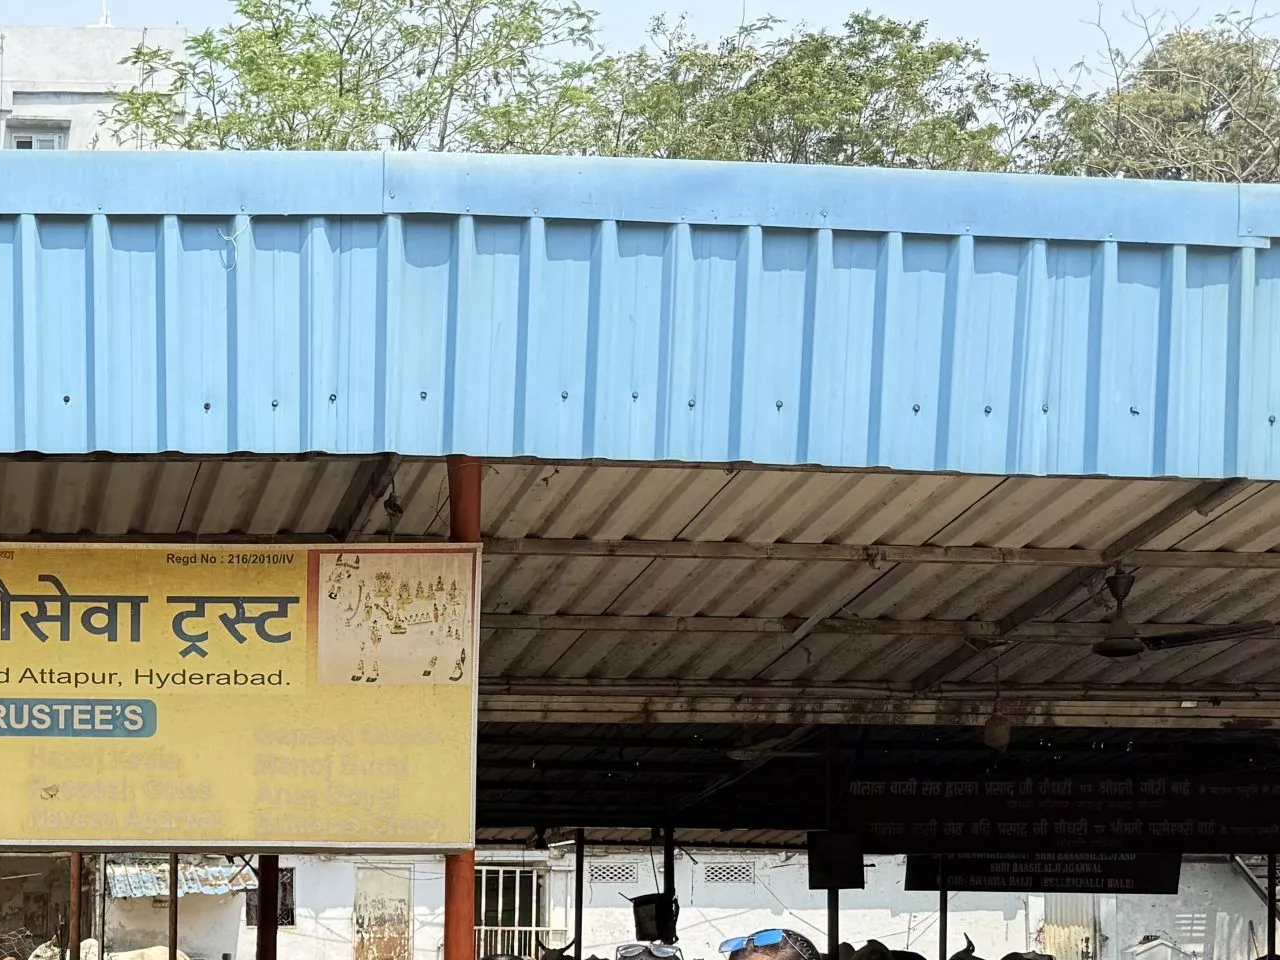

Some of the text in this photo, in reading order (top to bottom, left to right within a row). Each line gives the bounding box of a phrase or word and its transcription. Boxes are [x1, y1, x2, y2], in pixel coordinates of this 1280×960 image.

[166, 553, 197, 566] Regd
[200, 553, 217, 564] No
[227, 553, 295, 565] 216/2010/IV
[166, 595, 300, 658] ट्रस्ट
[18, 667, 123, 688] Attapur,
[134, 668, 291, 689] Hyderabad.
[990, 862, 1010, 873] SHRI
[1062, 863, 1103, 874] AGARWAL
